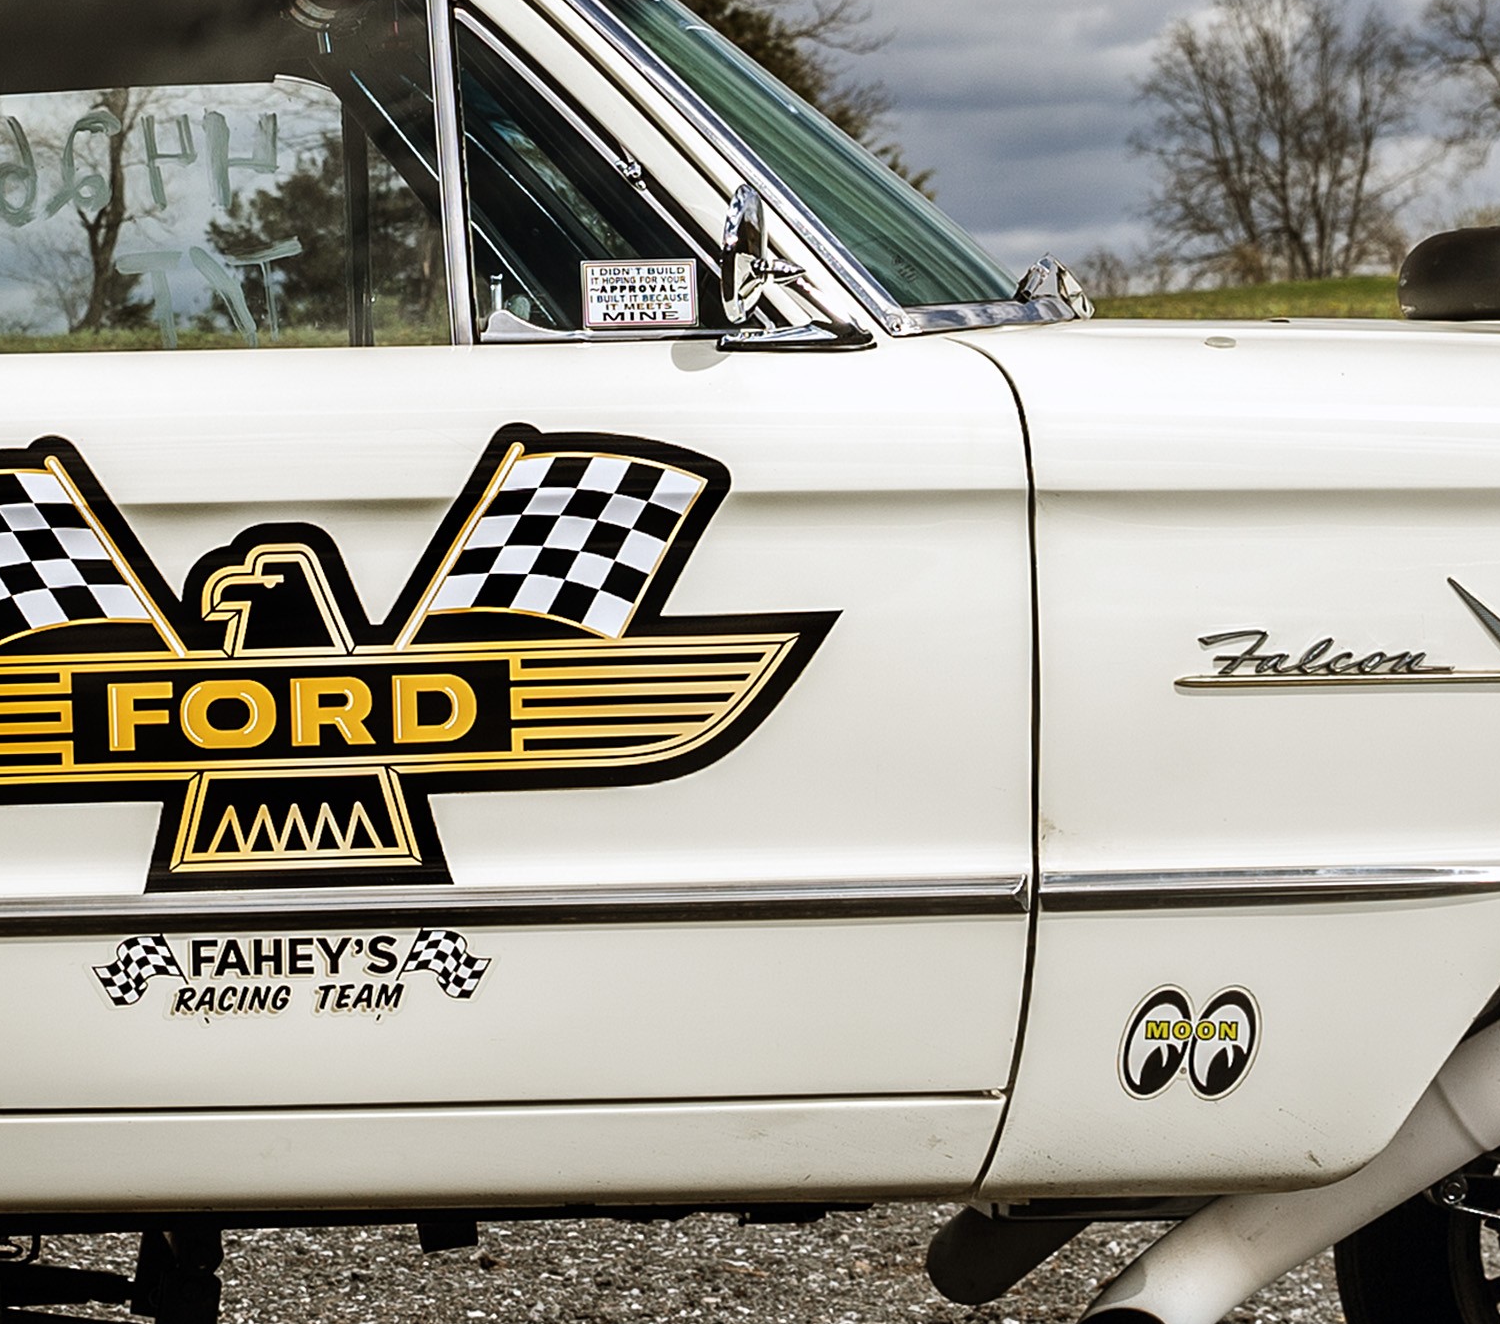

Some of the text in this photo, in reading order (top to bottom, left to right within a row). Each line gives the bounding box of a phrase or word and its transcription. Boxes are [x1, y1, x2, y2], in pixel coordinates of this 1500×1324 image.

[591, 266, 685, 276] I DIDN'T BUILD
[591, 276, 686, 285] IT HOPING FOR YOUR
[597, 295, 625, 303] BUILT
[629, 294, 638, 302] IT
[642, 293, 689, 302] BECAUSE
[605, 303, 619, 311] IT
[603, 311, 680, 321] MINE
[1197, 629, 1455, 676] Falcon
[107, 672, 478, 753] FORD
[190, 935, 399, 978] FAHEY'S
[172, 983, 405, 1015] RACING TEAM
[1144, 1018, 1239, 1042] MOON
